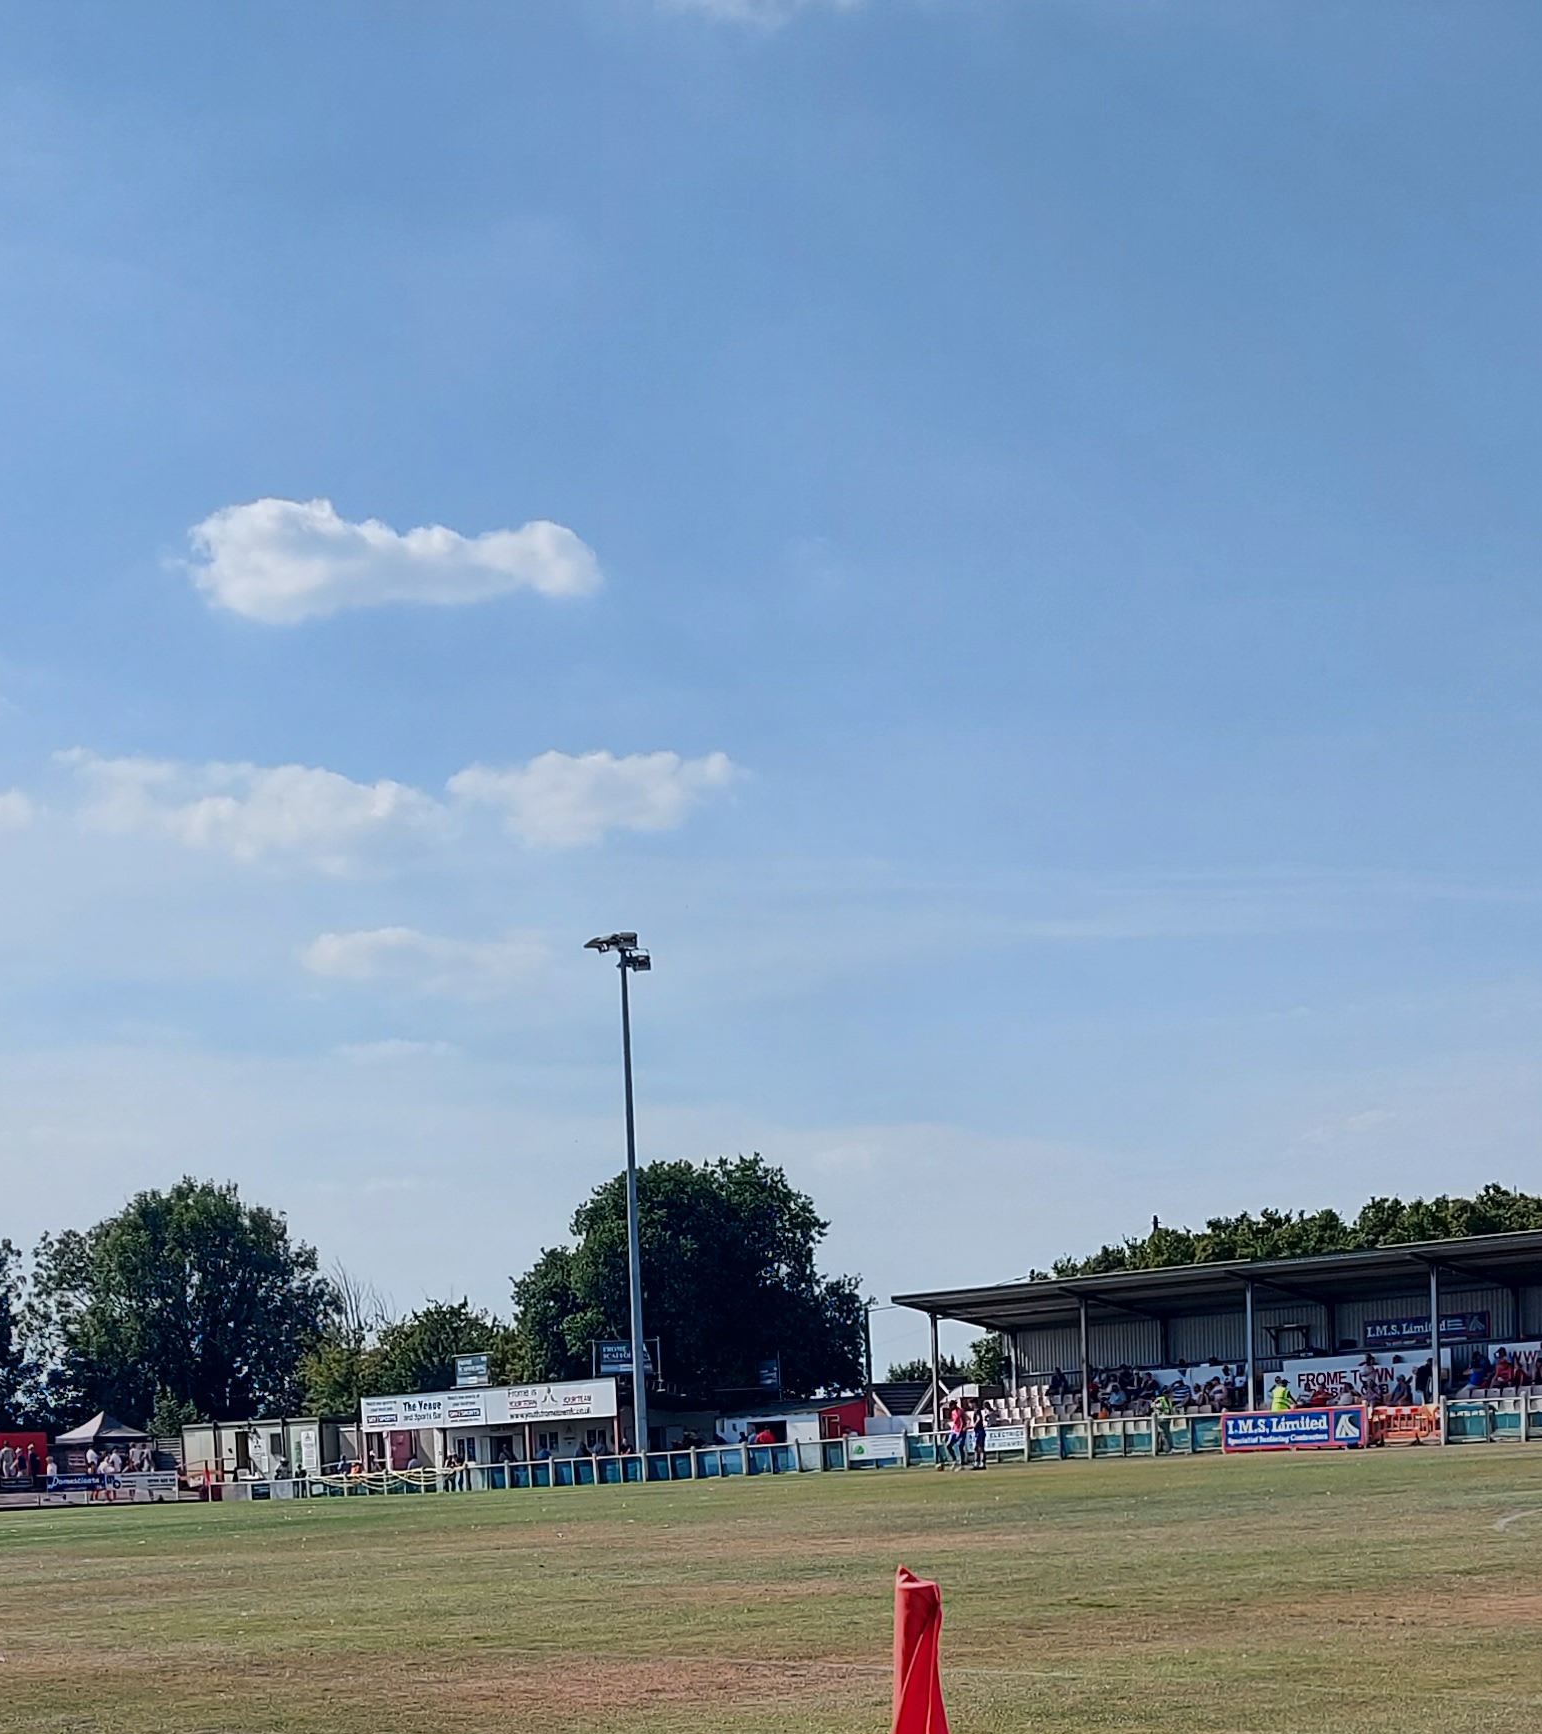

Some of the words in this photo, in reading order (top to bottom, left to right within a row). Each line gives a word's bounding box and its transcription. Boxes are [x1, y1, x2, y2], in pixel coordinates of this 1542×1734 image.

[1297, 1370, 1347, 1388] FROME
[507, 1388, 530, 1398] Frome
[531, 1388, 537, 1397] is
[402, 1401, 418, 1412] The
[419, 1400, 442, 1411] Venue
[403, 1413, 414, 1421] and
[414, 1412, 432, 1423] Sports
[433, 1411, 442, 1420] Bar
[1271, 1414, 1328, 1433] Limited
